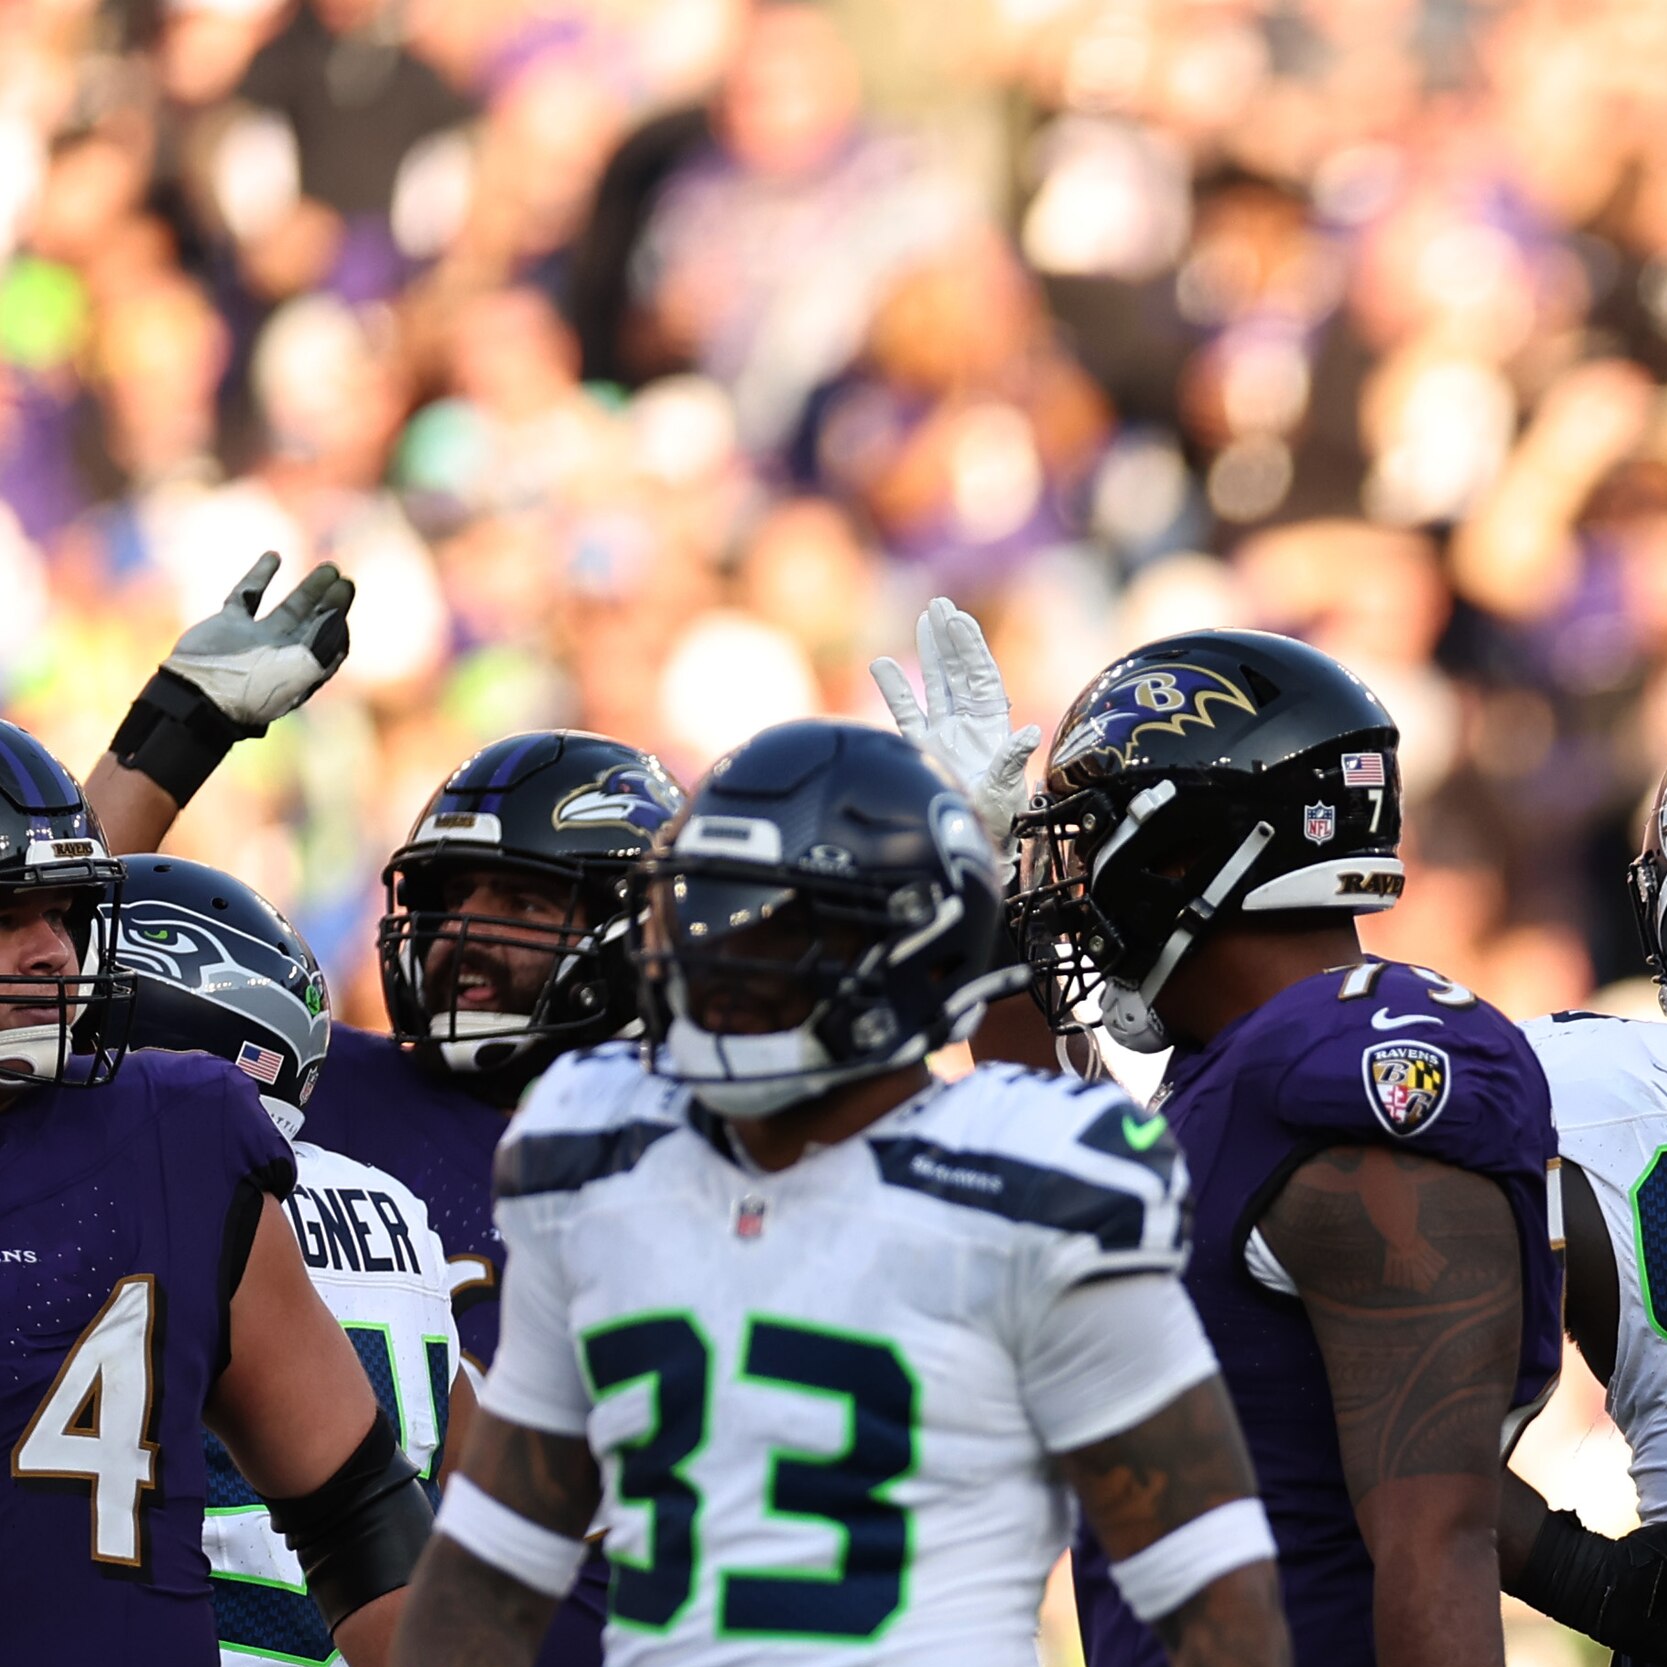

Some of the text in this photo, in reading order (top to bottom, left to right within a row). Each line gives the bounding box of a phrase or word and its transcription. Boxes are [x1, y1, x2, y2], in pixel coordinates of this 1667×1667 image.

[1309, 820, 1331, 838] NFL
[1374, 1048, 1440, 1066] RAVENS
[286, 1183, 422, 1275] GNER
[578, 1308, 925, 1648] 33
